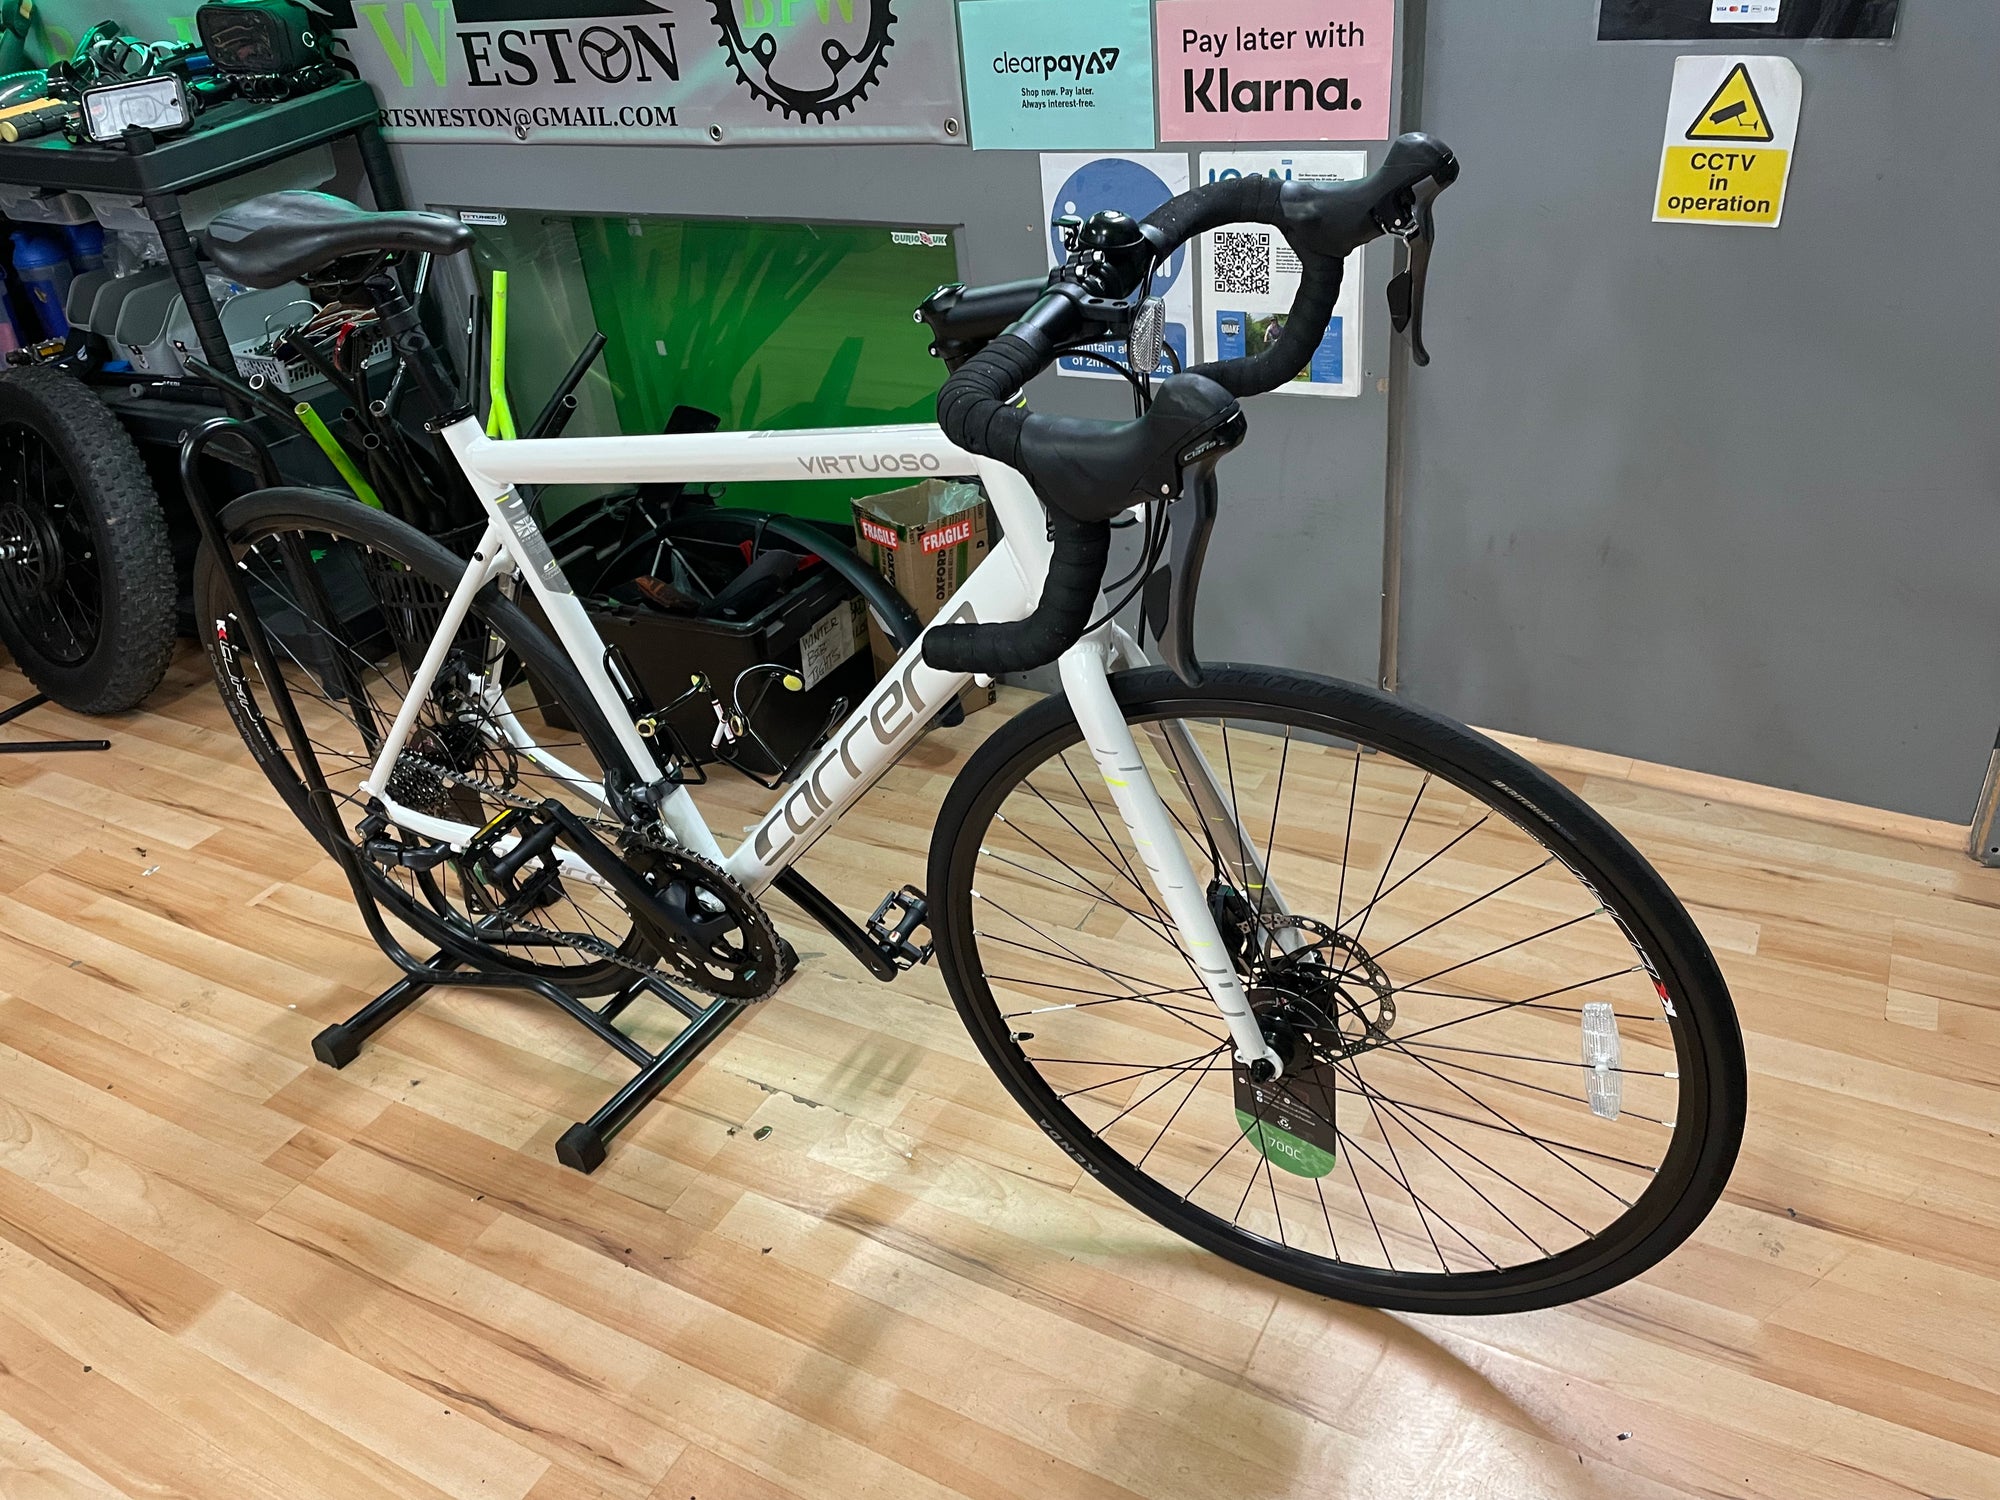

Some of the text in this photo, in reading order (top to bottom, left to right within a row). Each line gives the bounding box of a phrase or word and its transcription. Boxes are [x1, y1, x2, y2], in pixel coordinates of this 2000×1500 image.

[1182, 21, 1365, 58] Pay later with
[993, 51, 1085, 81] clearpay
[1021, 86, 1094, 97] Shop now. Pay later.
[1184, 67, 1362, 113] Klarna.
[1022, 98, 1095, 109] Always interest-free.
[1690, 152, 1756, 172] CCTV
[1708, 173, 1728, 191] in
[1667, 195, 1770, 213] operation
[1069, 342, 1115, 353] aintain
[1072, 356, 1083, 366] of
[797, 453, 940, 474] VIRTUOSO
[862, 521, 897, 548] FRAGILE
[923, 522, 970, 552] FRAGILE
[936, 549, 946, 600] OXFORD
[1040, 1118, 1101, 1175] KENDA
